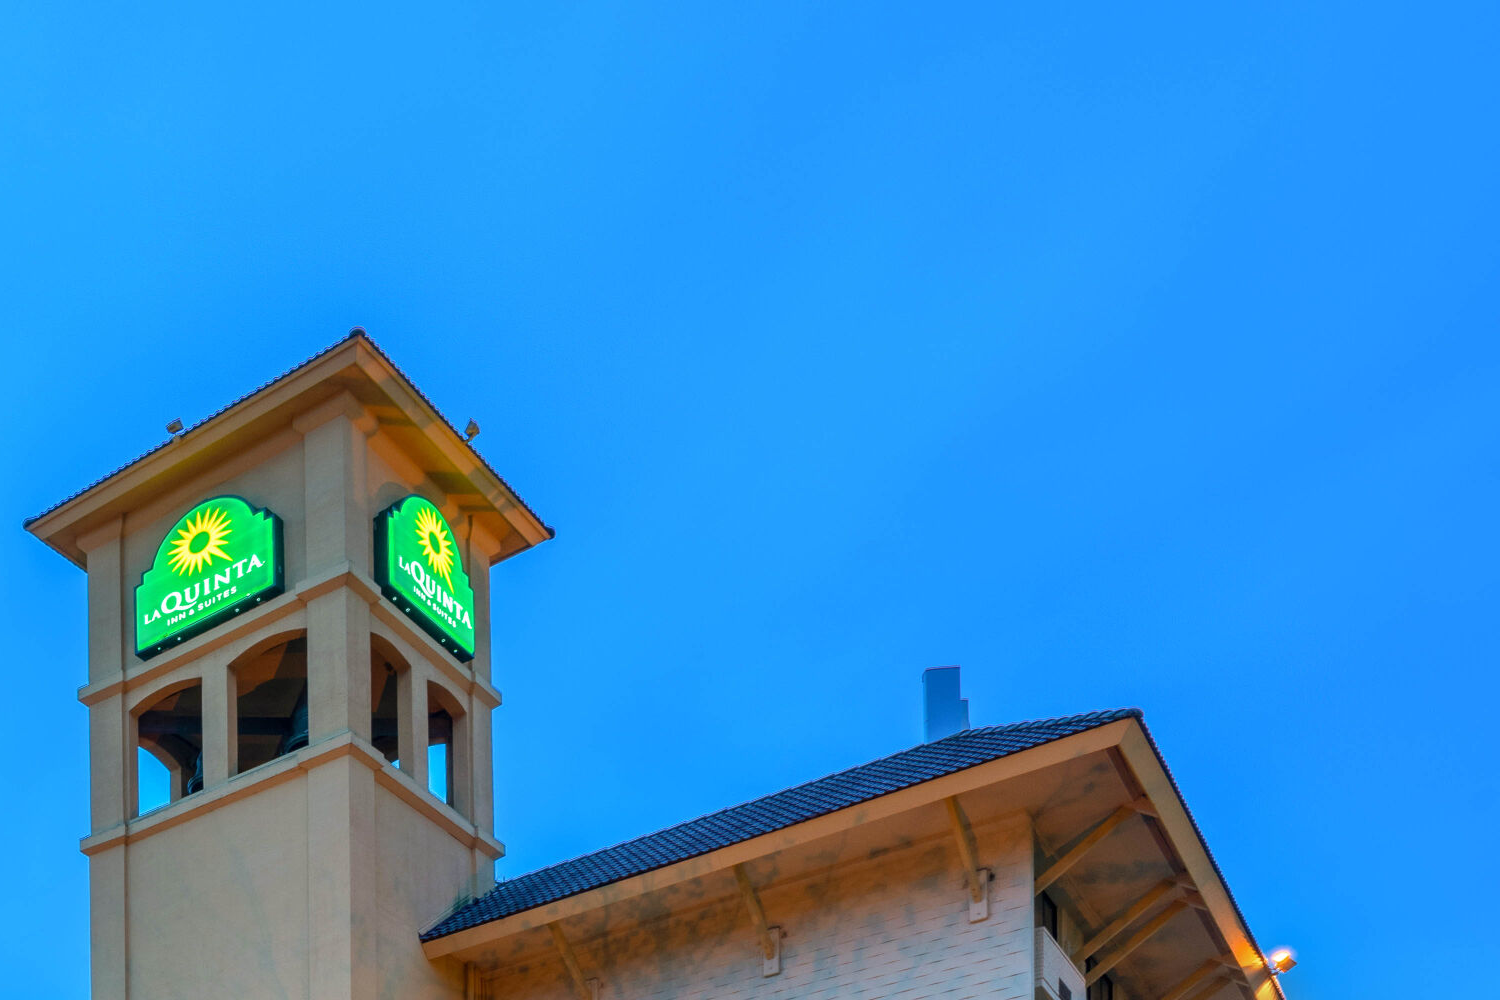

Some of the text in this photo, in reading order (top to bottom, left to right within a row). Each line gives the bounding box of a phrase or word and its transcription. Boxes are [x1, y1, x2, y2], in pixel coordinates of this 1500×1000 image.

[161, 554, 264, 614] QUINTA
[167, 611, 186, 626] INN
[197, 586, 237, 611] SUITES
[411, 561, 472, 629] QUINTA
